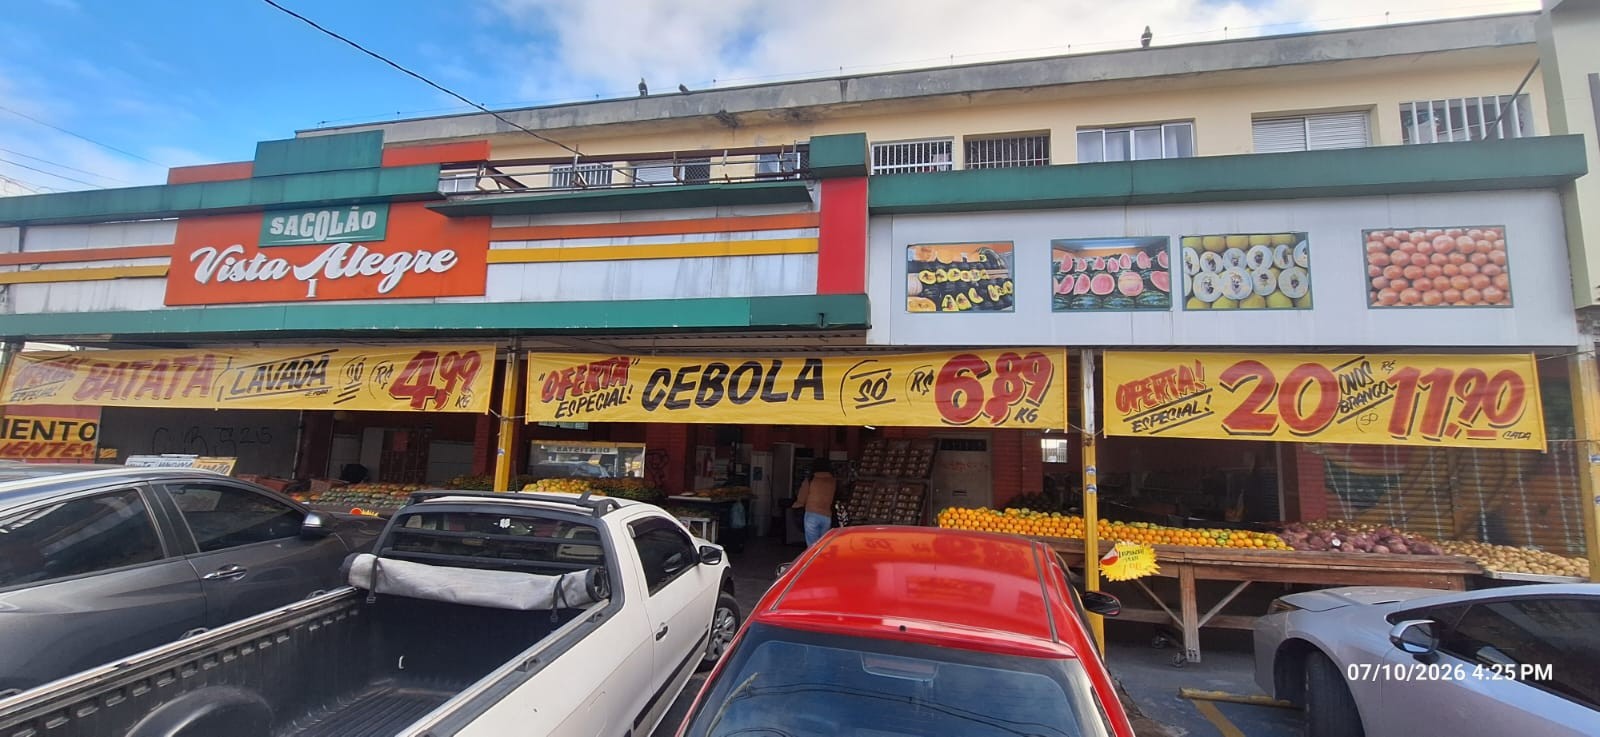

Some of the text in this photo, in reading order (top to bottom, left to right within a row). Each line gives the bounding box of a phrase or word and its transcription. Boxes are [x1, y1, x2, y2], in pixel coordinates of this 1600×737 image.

[269, 206, 377, 242] SACOLÃO
[189, 243, 458, 294] Vista Alegre
[73, 354, 216, 400] BATATA
[230, 353, 330, 395] LAVADA
[388, 350, 483, 411] 4,99
[641, 358, 825, 411] CEBOLA
[853, 351, 1054, 426] SÓ R$ 6,89
[1218, 359, 1340, 437] 20
[1014, 407, 1038, 424] KG
